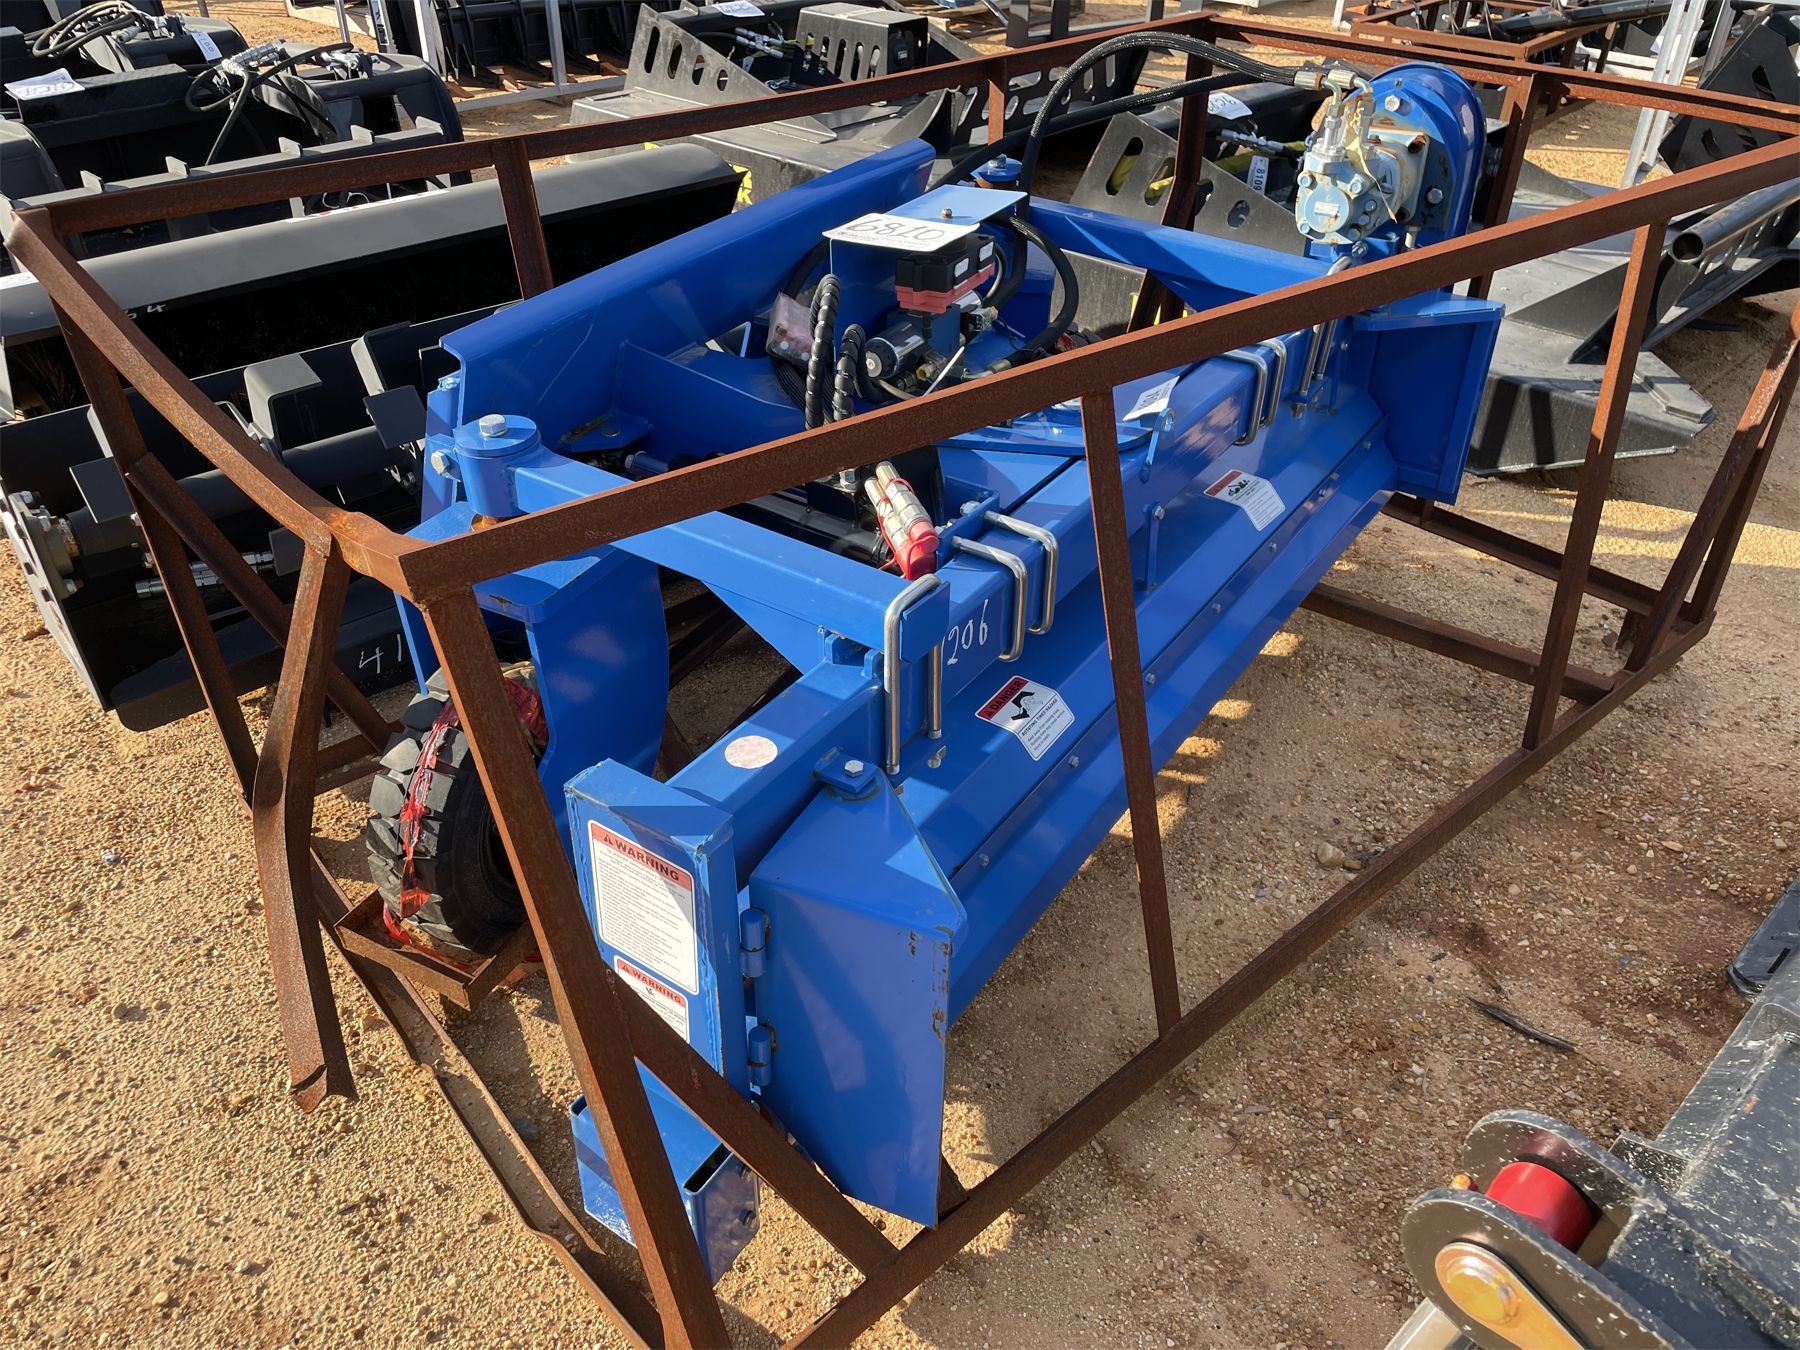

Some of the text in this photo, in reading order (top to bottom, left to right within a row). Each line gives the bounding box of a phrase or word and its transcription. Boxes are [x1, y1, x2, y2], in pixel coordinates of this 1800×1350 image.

[1253, 168, 1266, 191] 8109
[845, 218, 945, 241] 6810
[992, 680, 1025, 712] DANGER
[615, 839, 679, 881] WARNING
[633, 970, 681, 1003] WARNING
